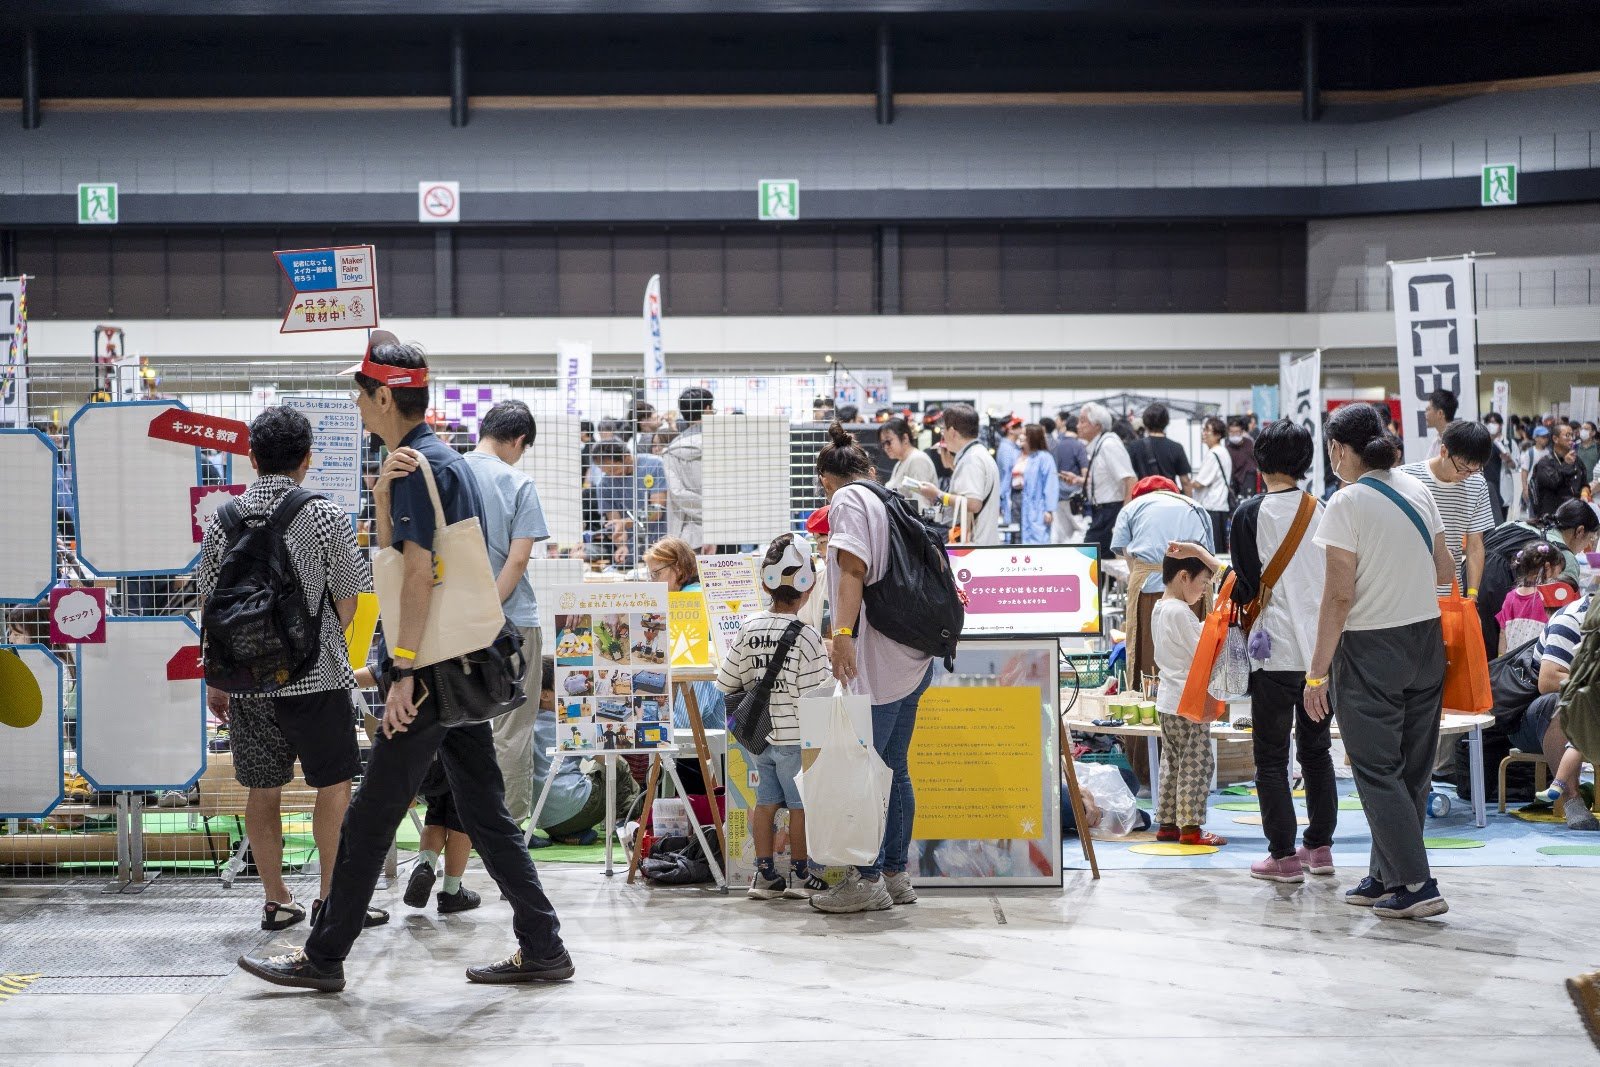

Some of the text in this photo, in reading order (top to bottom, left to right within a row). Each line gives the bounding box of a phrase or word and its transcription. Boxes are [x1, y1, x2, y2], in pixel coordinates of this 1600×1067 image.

[342, 257, 363, 265] Maker
[342, 265, 359, 273] Faire
[343, 273, 363, 282] Tokyo
[961, 571, 967, 579] 3
[971, 587, 997, 595] どうぐと
[998, 586, 1024, 594] そざいは
[1046, 585, 1073, 593] ばしょへ
[61, 608, 94, 624] チェック!
